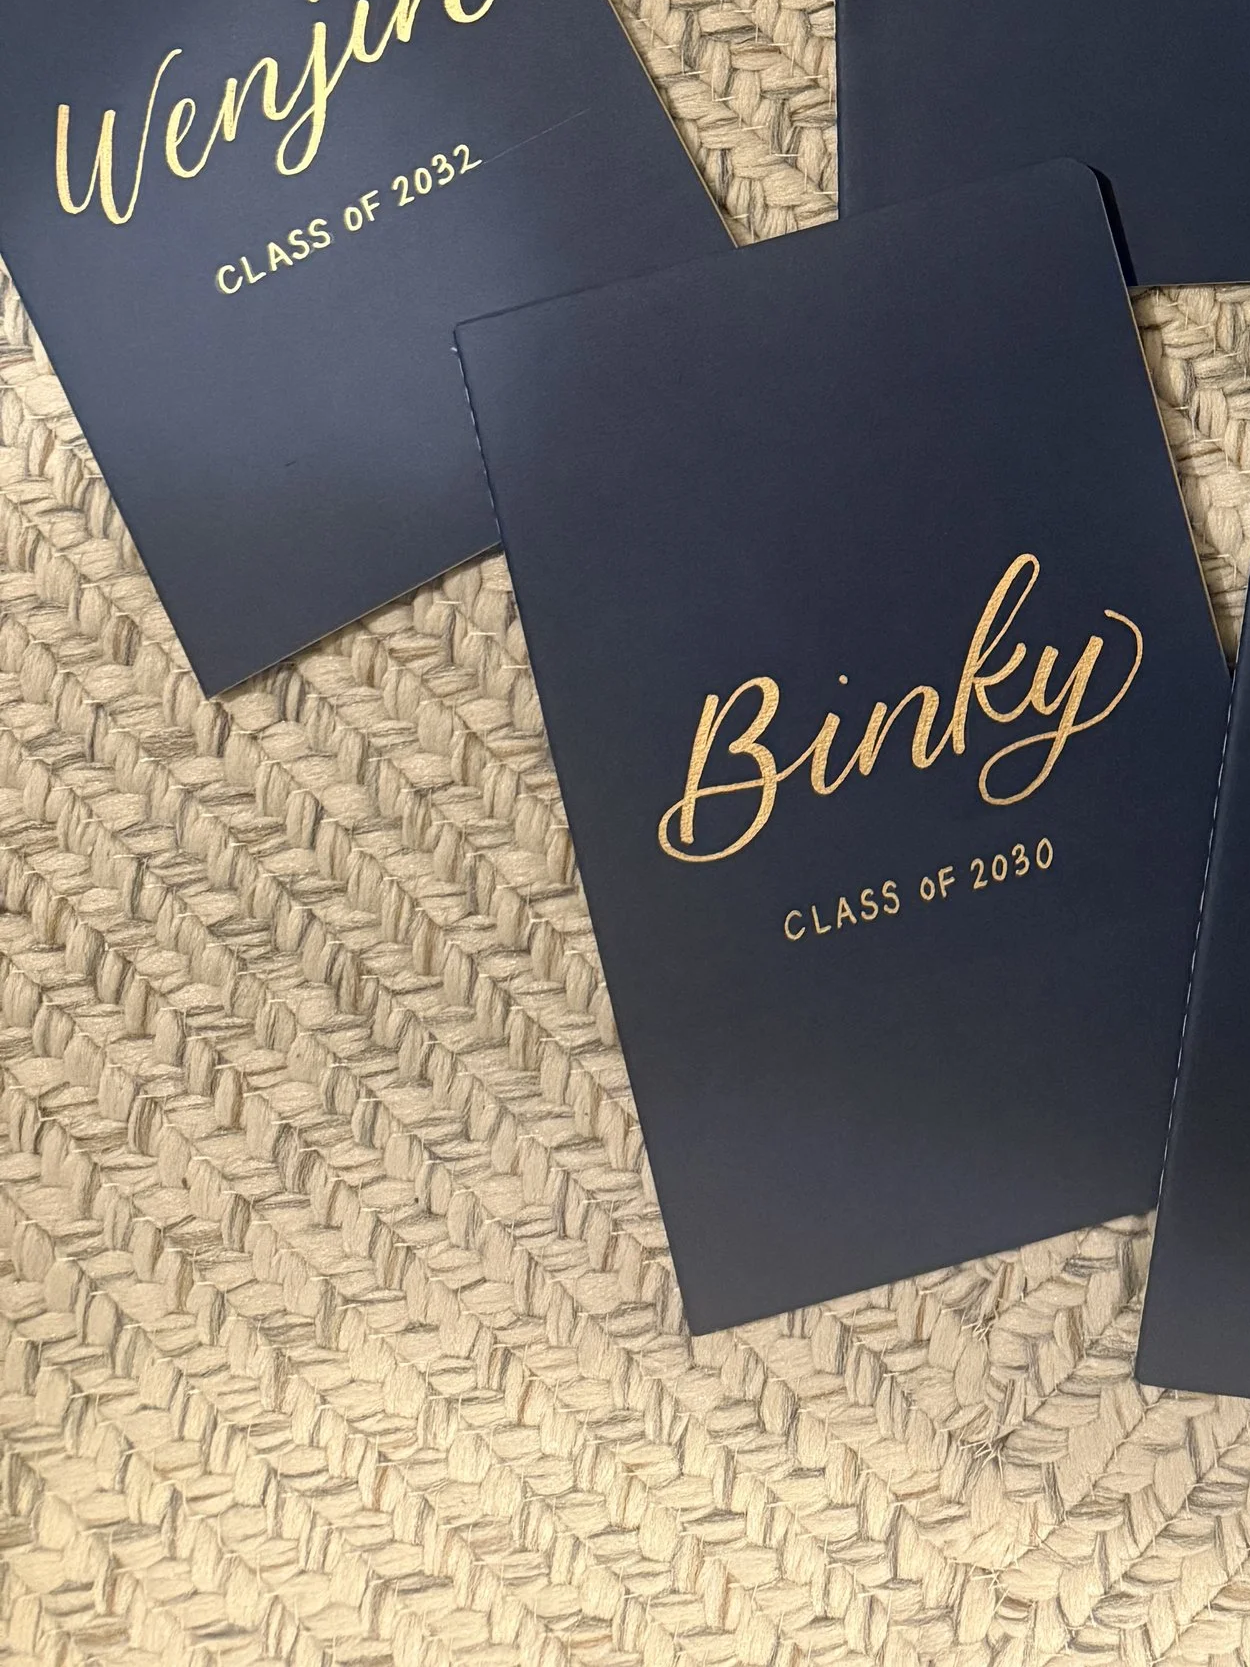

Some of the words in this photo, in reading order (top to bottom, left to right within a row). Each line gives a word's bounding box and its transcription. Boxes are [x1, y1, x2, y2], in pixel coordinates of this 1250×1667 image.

[215, 217, 332, 295] CLASS
[342, 190, 381, 233] OF
[390, 143, 482, 207] 2032
[656, 552, 1144, 865] Binky
[782, 879, 900, 942] CLASS
[918, 863, 957, 903] OF
[968, 837, 1055, 892] 2030
